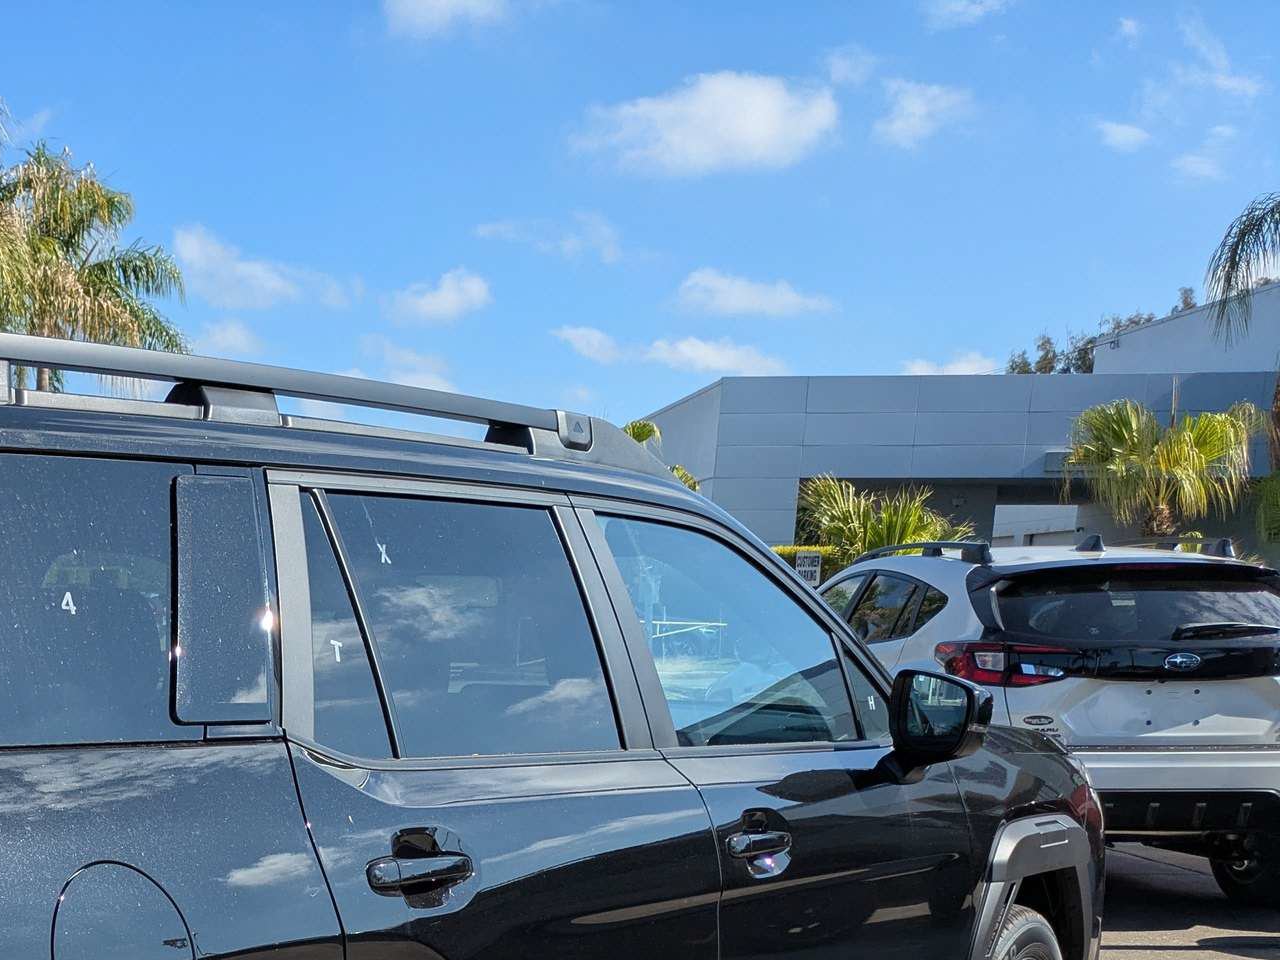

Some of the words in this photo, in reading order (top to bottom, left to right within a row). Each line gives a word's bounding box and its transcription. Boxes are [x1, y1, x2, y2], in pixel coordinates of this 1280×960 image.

[61, 591, 77, 615] 4
[330, 639, 344, 662] T
[867, 695, 876, 710] H
